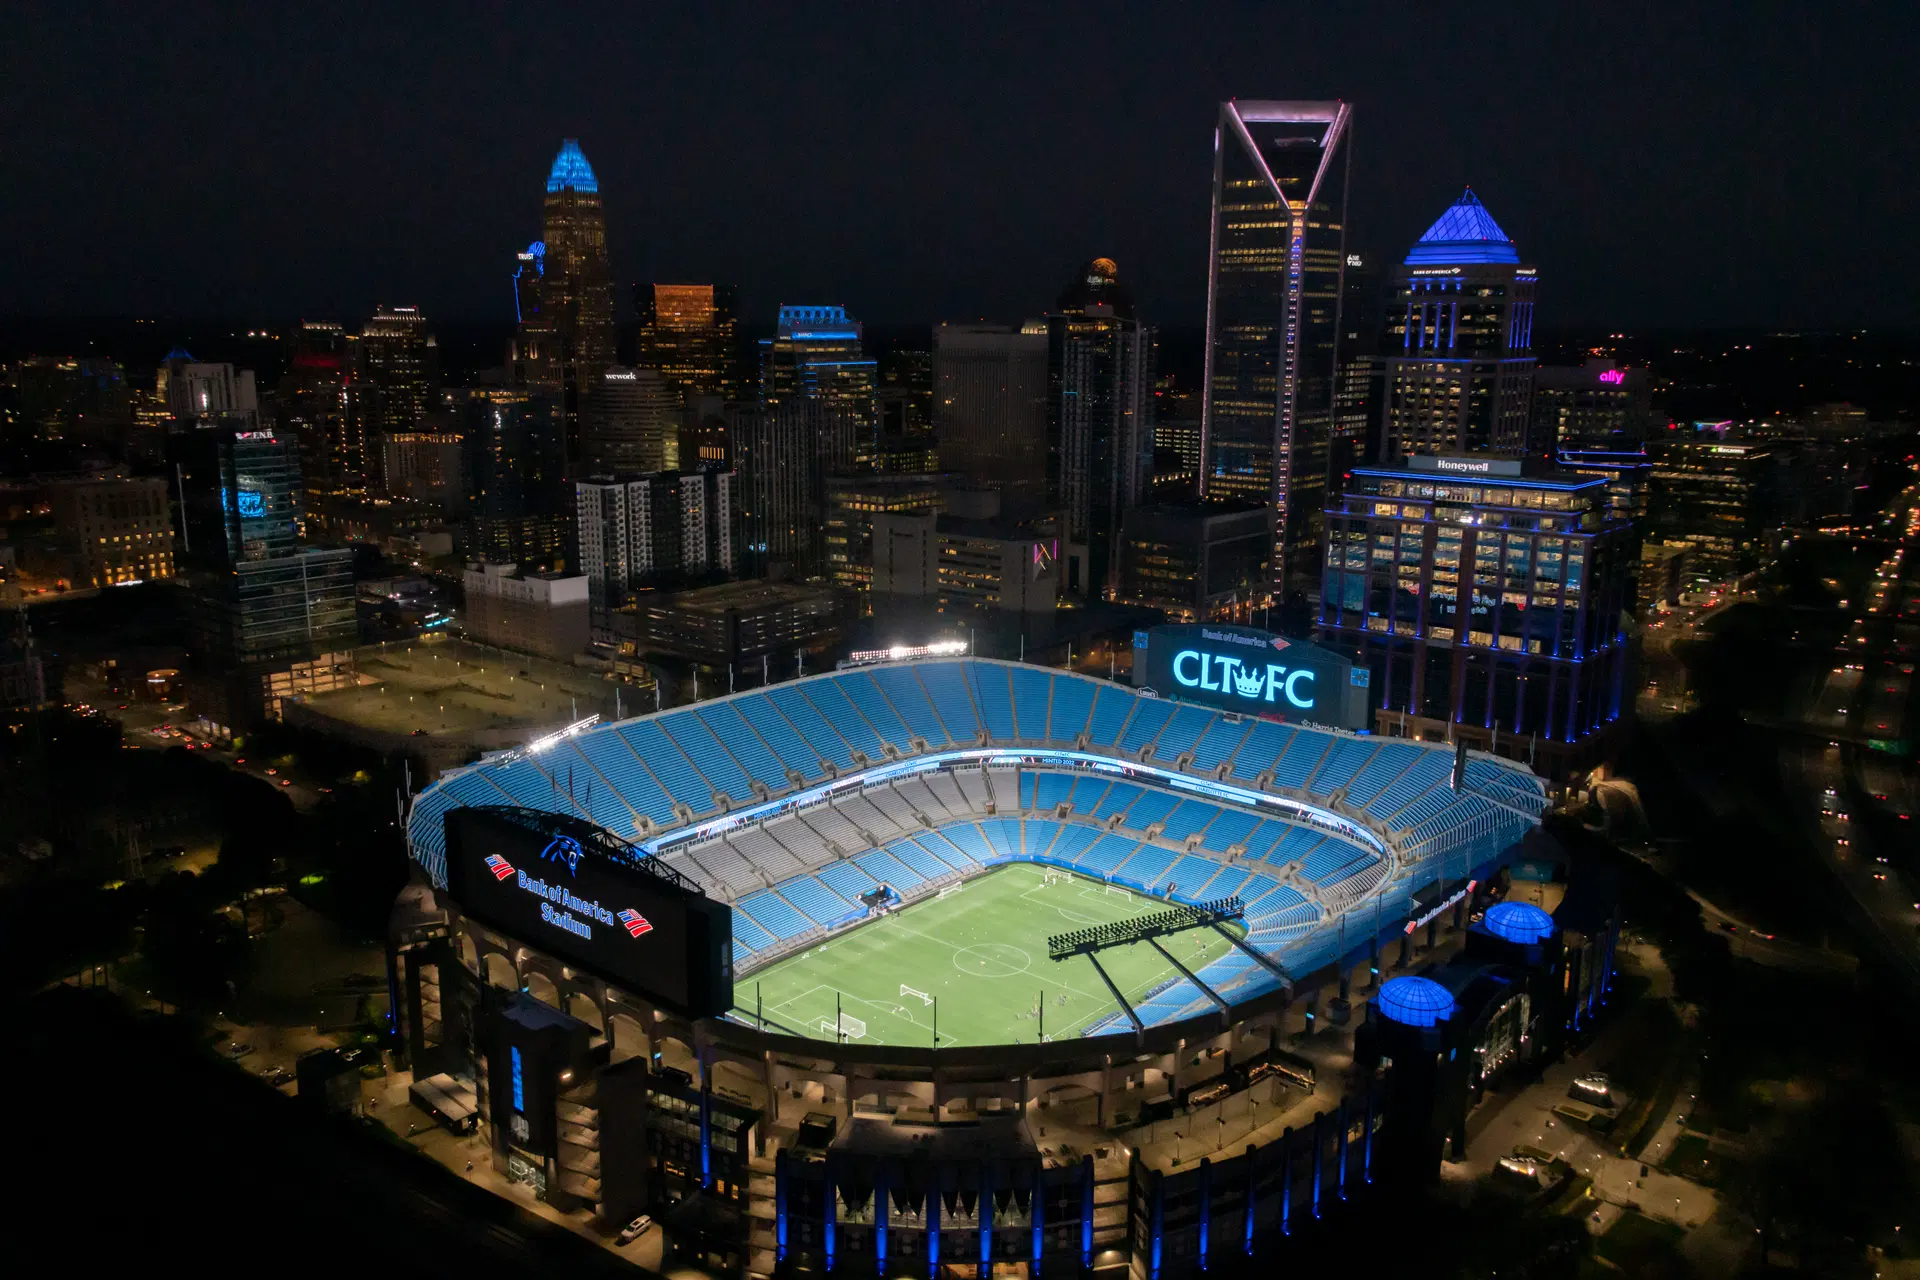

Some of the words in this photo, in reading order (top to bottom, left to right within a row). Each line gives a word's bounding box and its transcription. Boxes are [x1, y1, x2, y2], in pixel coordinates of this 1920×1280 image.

[605, 372, 636, 380] wework
[1600, 370, 1625, 384] ally
[1437, 460, 1489, 472] Honeywell
[1202, 628, 1223, 641] Bank
[1223, 632, 1233, 642] of
[1232, 633, 1267, 648] America
[1312, 722, 1333, 732] Harris
[518, 869, 548, 899] Bank
[549, 884, 561, 904] of
[562, 888, 614, 926] America
[541, 902, 592, 940] Stadium
